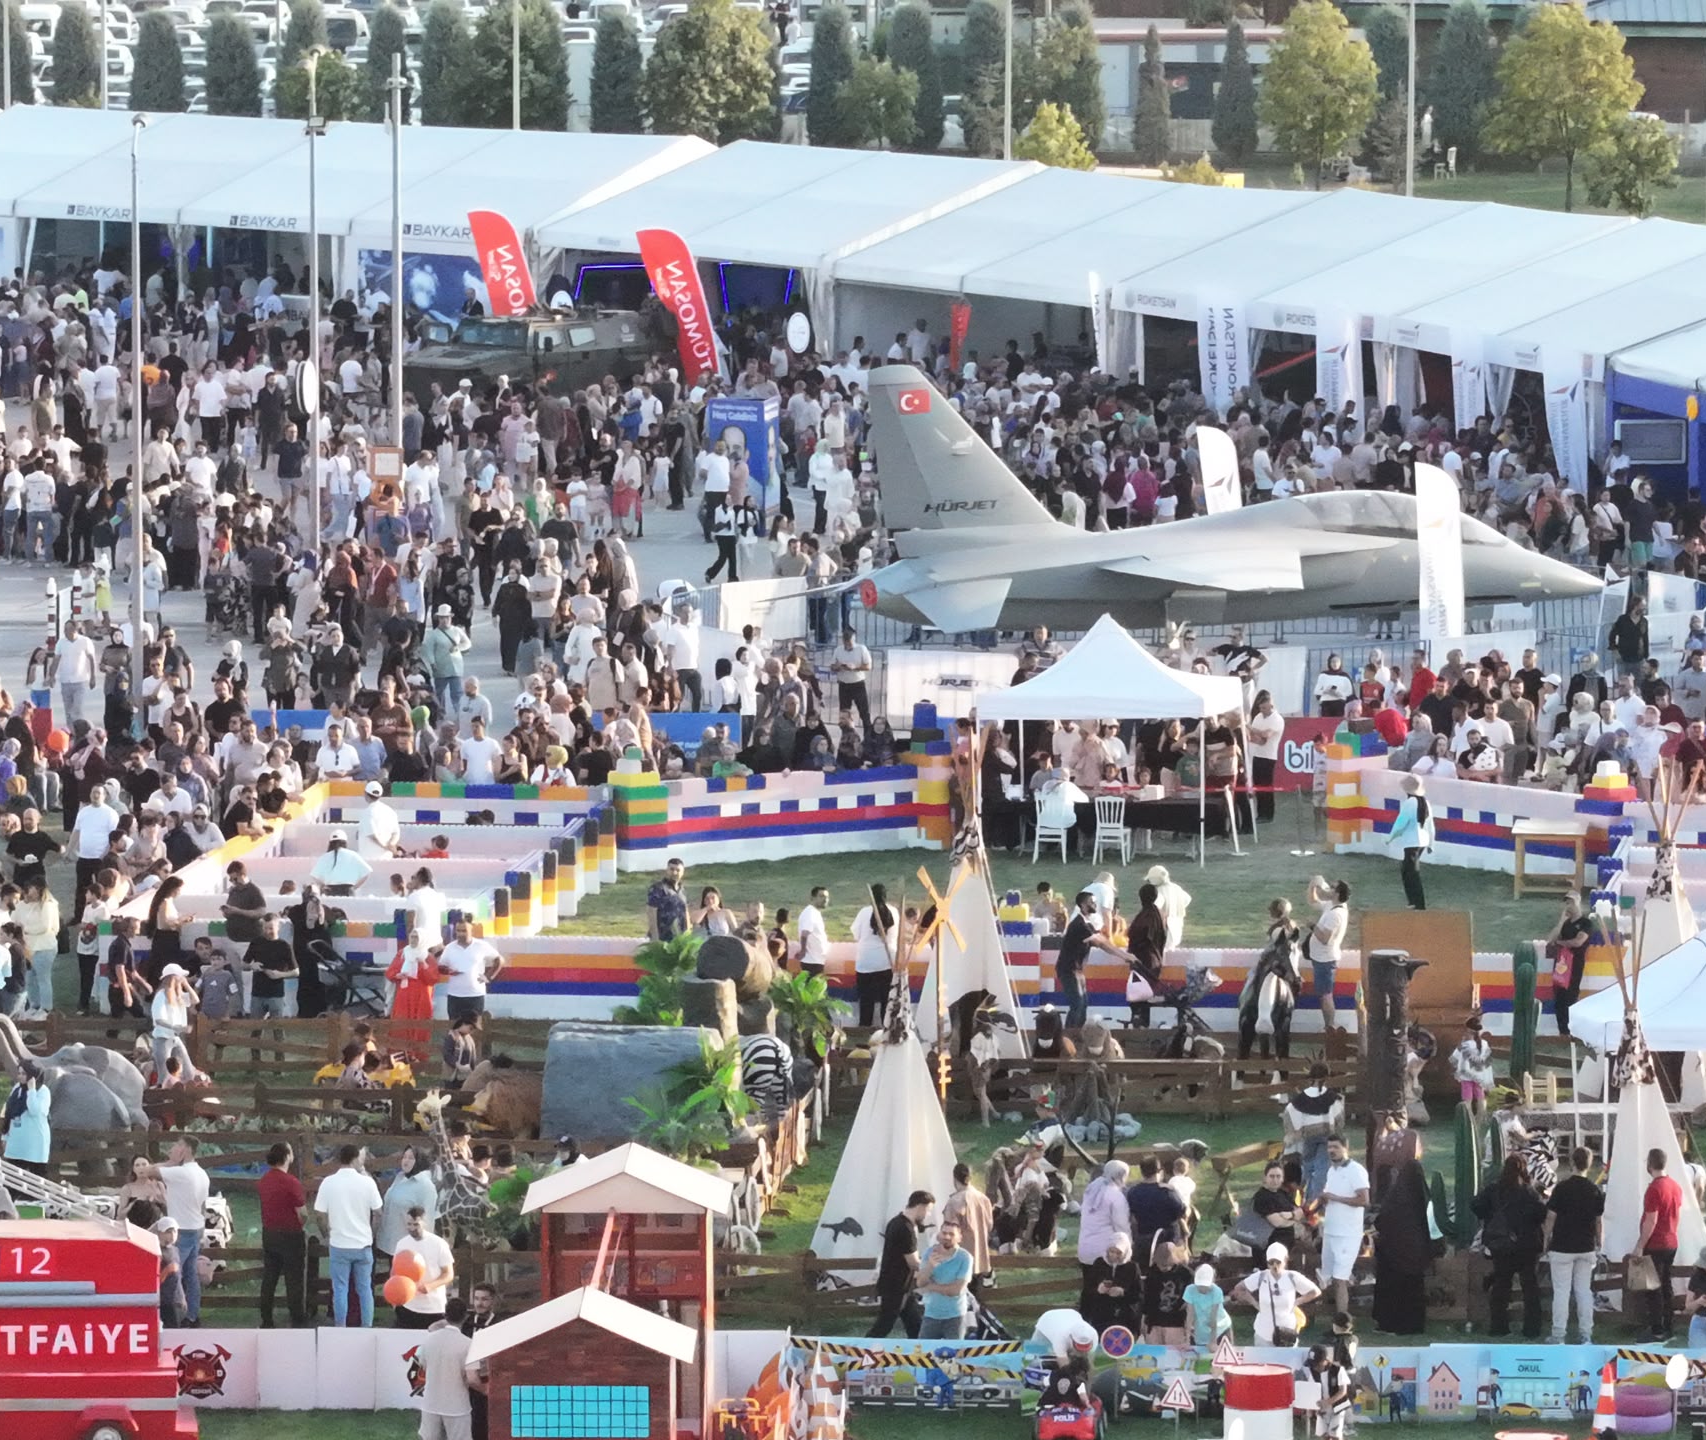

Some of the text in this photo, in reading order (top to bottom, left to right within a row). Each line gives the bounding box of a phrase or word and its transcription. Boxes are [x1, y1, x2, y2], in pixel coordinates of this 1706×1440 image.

[76, 205, 132, 219] BAYKAR
[239, 216, 298, 229] BAYKAR
[413, 224, 471, 238] BAYKAR
[1286, 312, 1317, 326] ROKETS
[924, 499, 998, 516] HÜRJET
[1286, 742, 1314, 771] bil
[1517, 1364, 1542, 1373] OKUL
